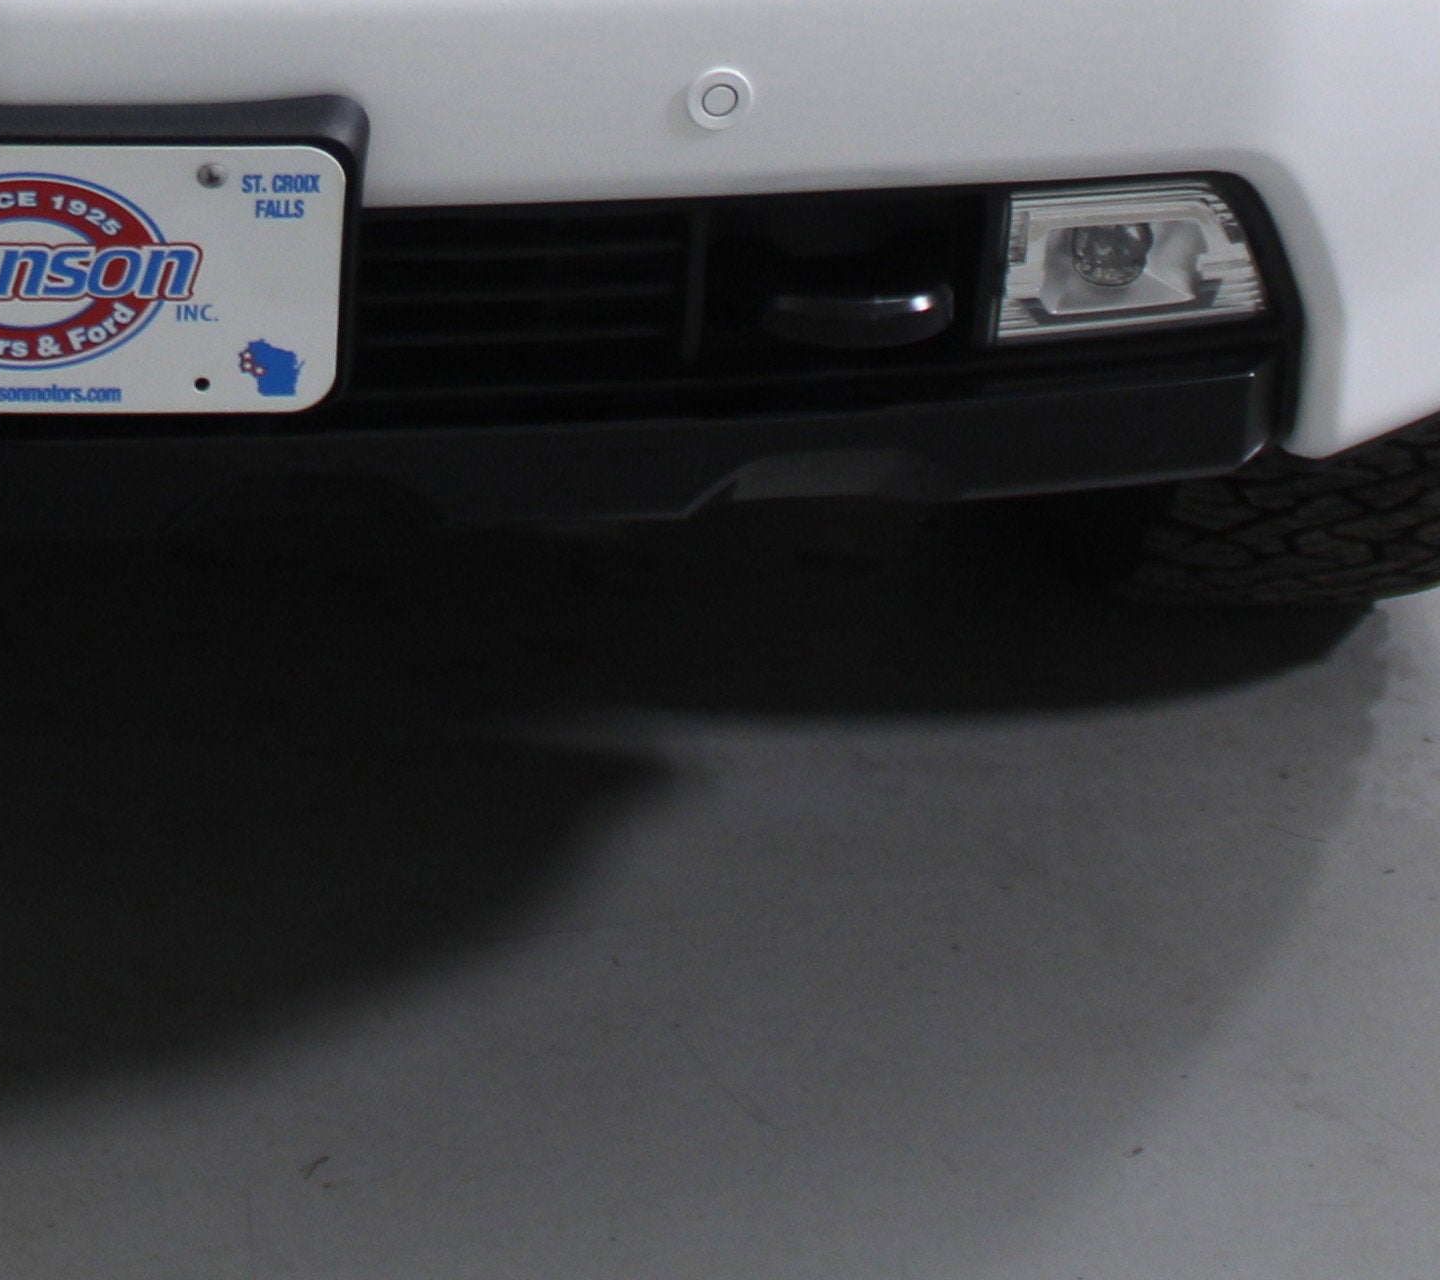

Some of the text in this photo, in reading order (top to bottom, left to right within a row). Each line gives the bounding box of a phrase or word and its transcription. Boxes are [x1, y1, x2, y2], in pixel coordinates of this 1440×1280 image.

[241, 174, 321, 194] ST. CROIX
[50, 193, 123, 237] 1925
[254, 199, 305, 219] FALLS
[175, 304, 219, 323] INC.
[36, 335, 63, 359] &
[66, 301, 137, 352] Ford
